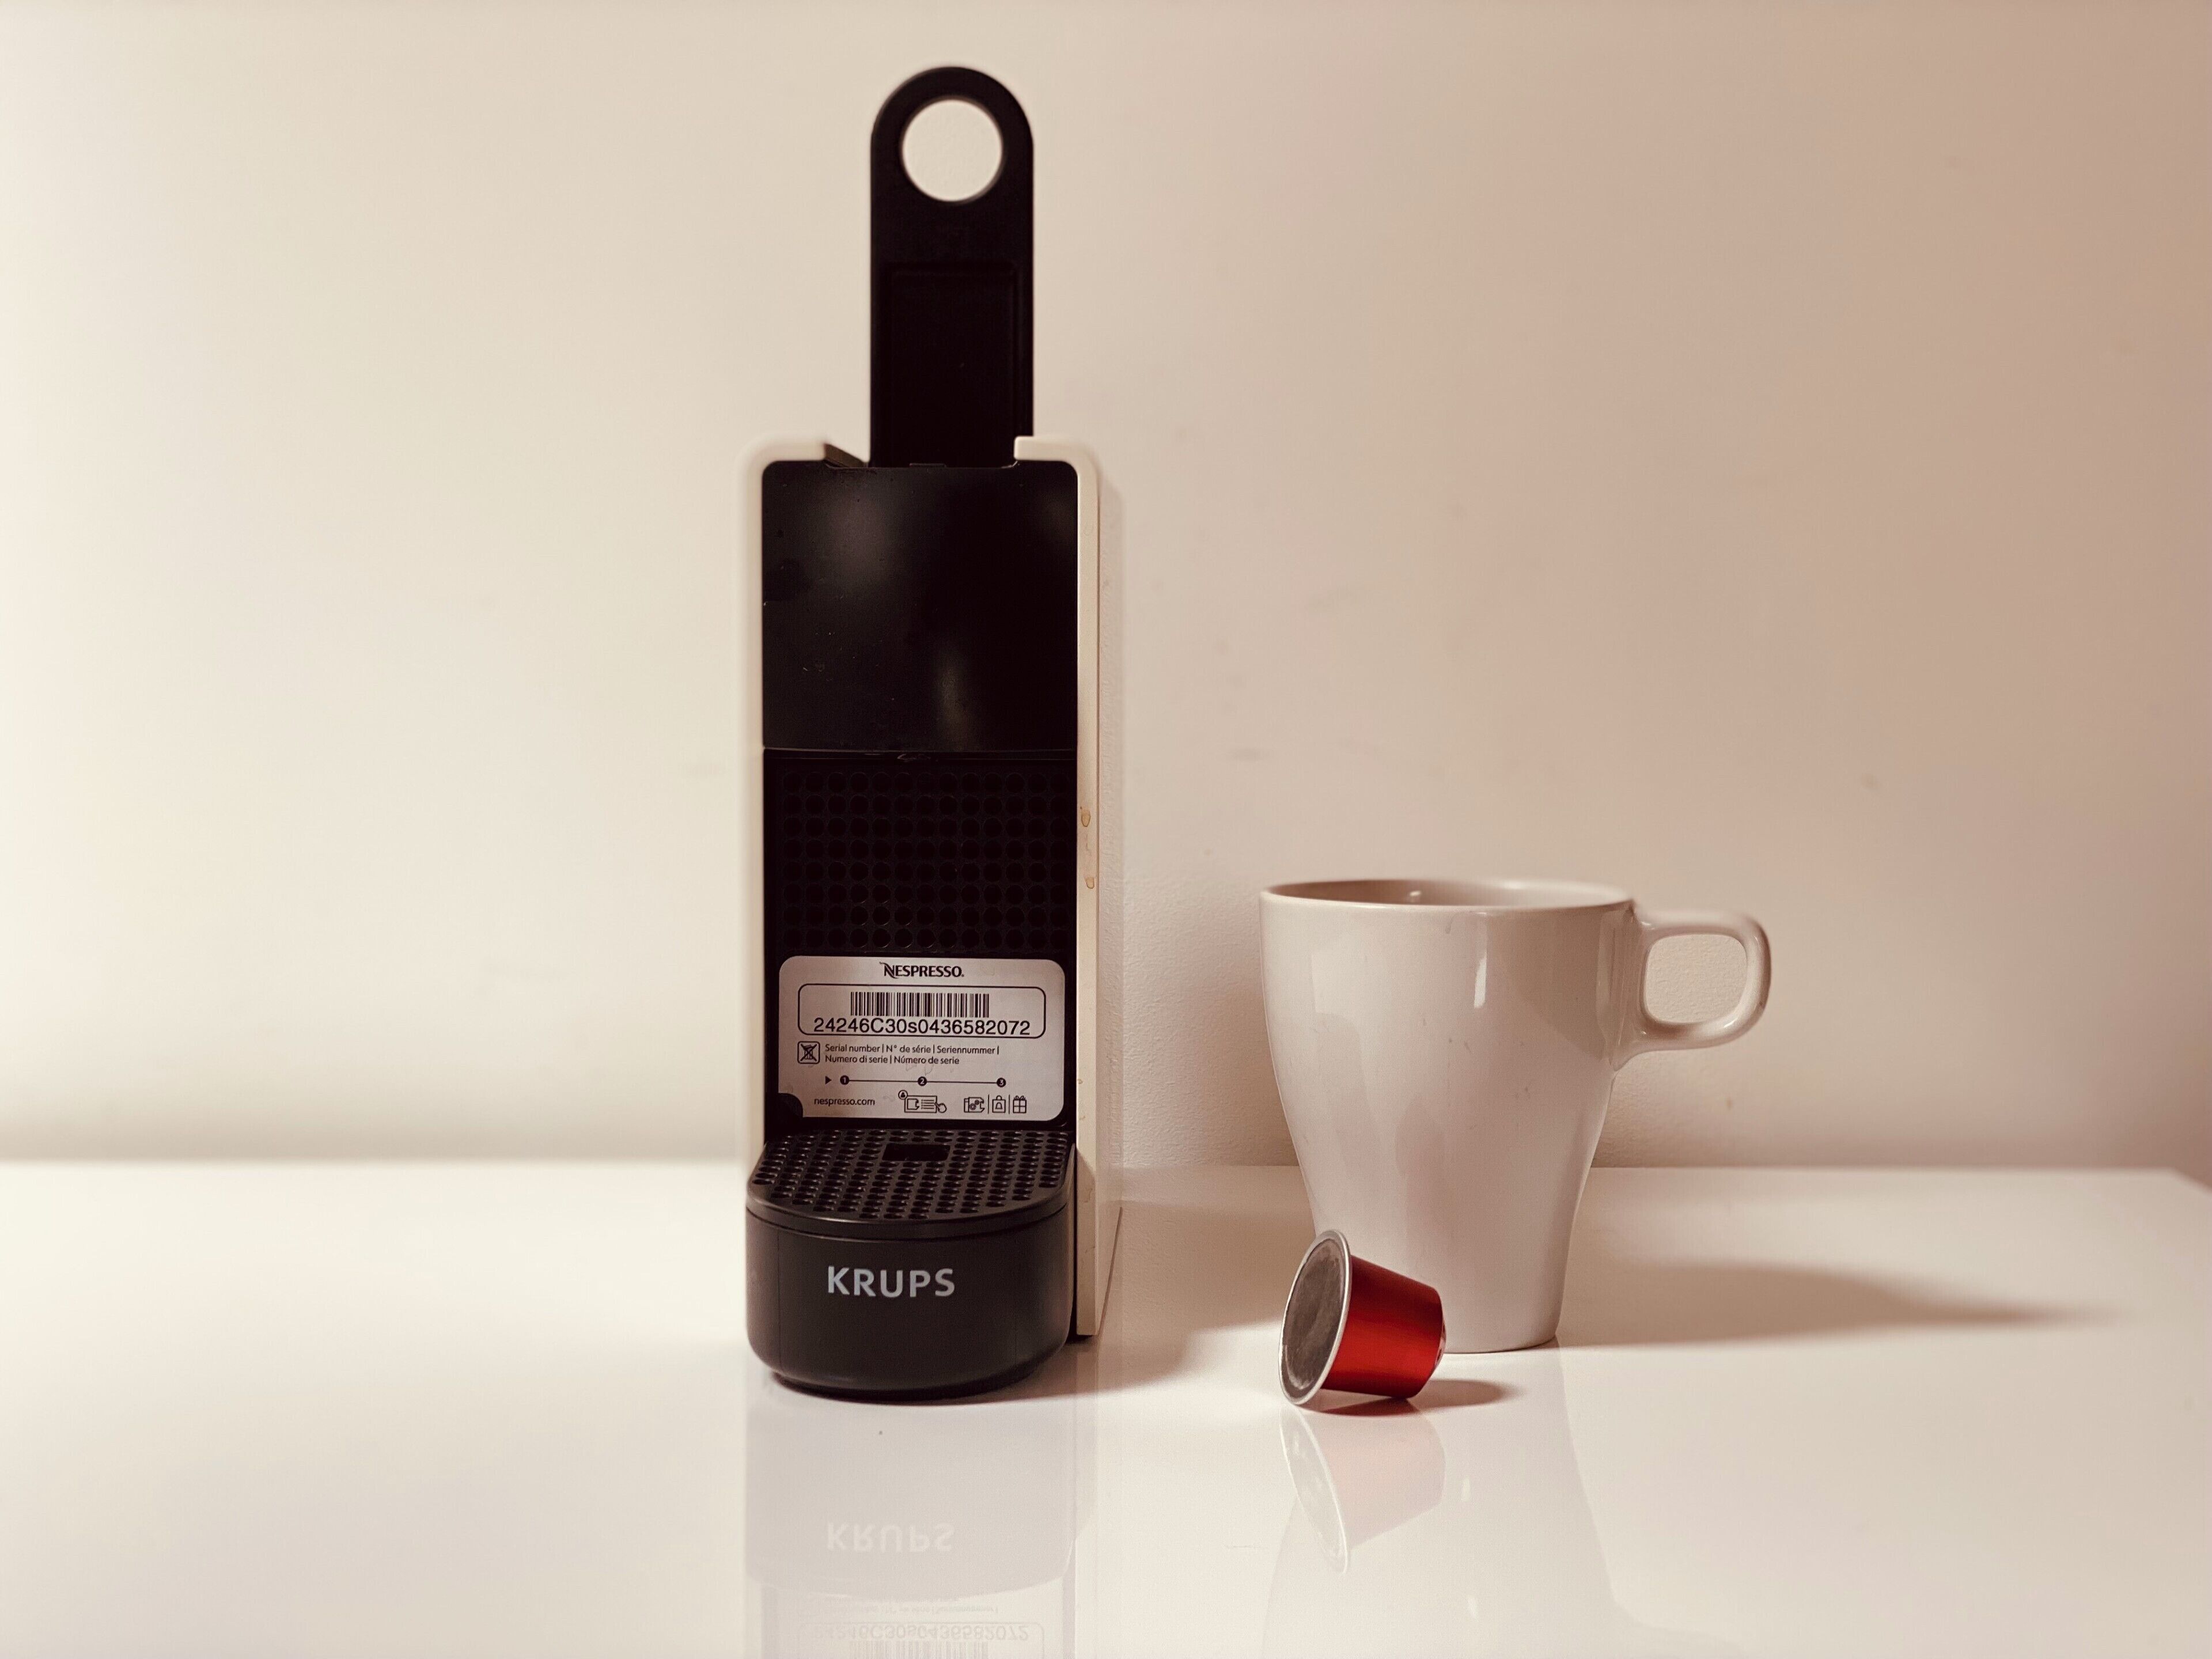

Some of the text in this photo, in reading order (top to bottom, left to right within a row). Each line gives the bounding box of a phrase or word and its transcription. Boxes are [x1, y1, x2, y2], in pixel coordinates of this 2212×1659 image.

[813, 1017, 1031, 1035] 24246C30s0436582072
[825, 1044, 847, 1052] Serial
[912, 1044, 931, 1053] série
[937, 1046, 995, 1054] Seriennummer
[859, 1055, 867, 1063] di
[869, 1055, 888, 1063] serie
[894, 1055, 926, 1064] Número
[928, 1056, 939, 1064] de
[940, 1056, 960, 1065] serie
[814, 1098, 875, 1107] nespresso.com
[828, 1266, 955, 1298] KRUPS
